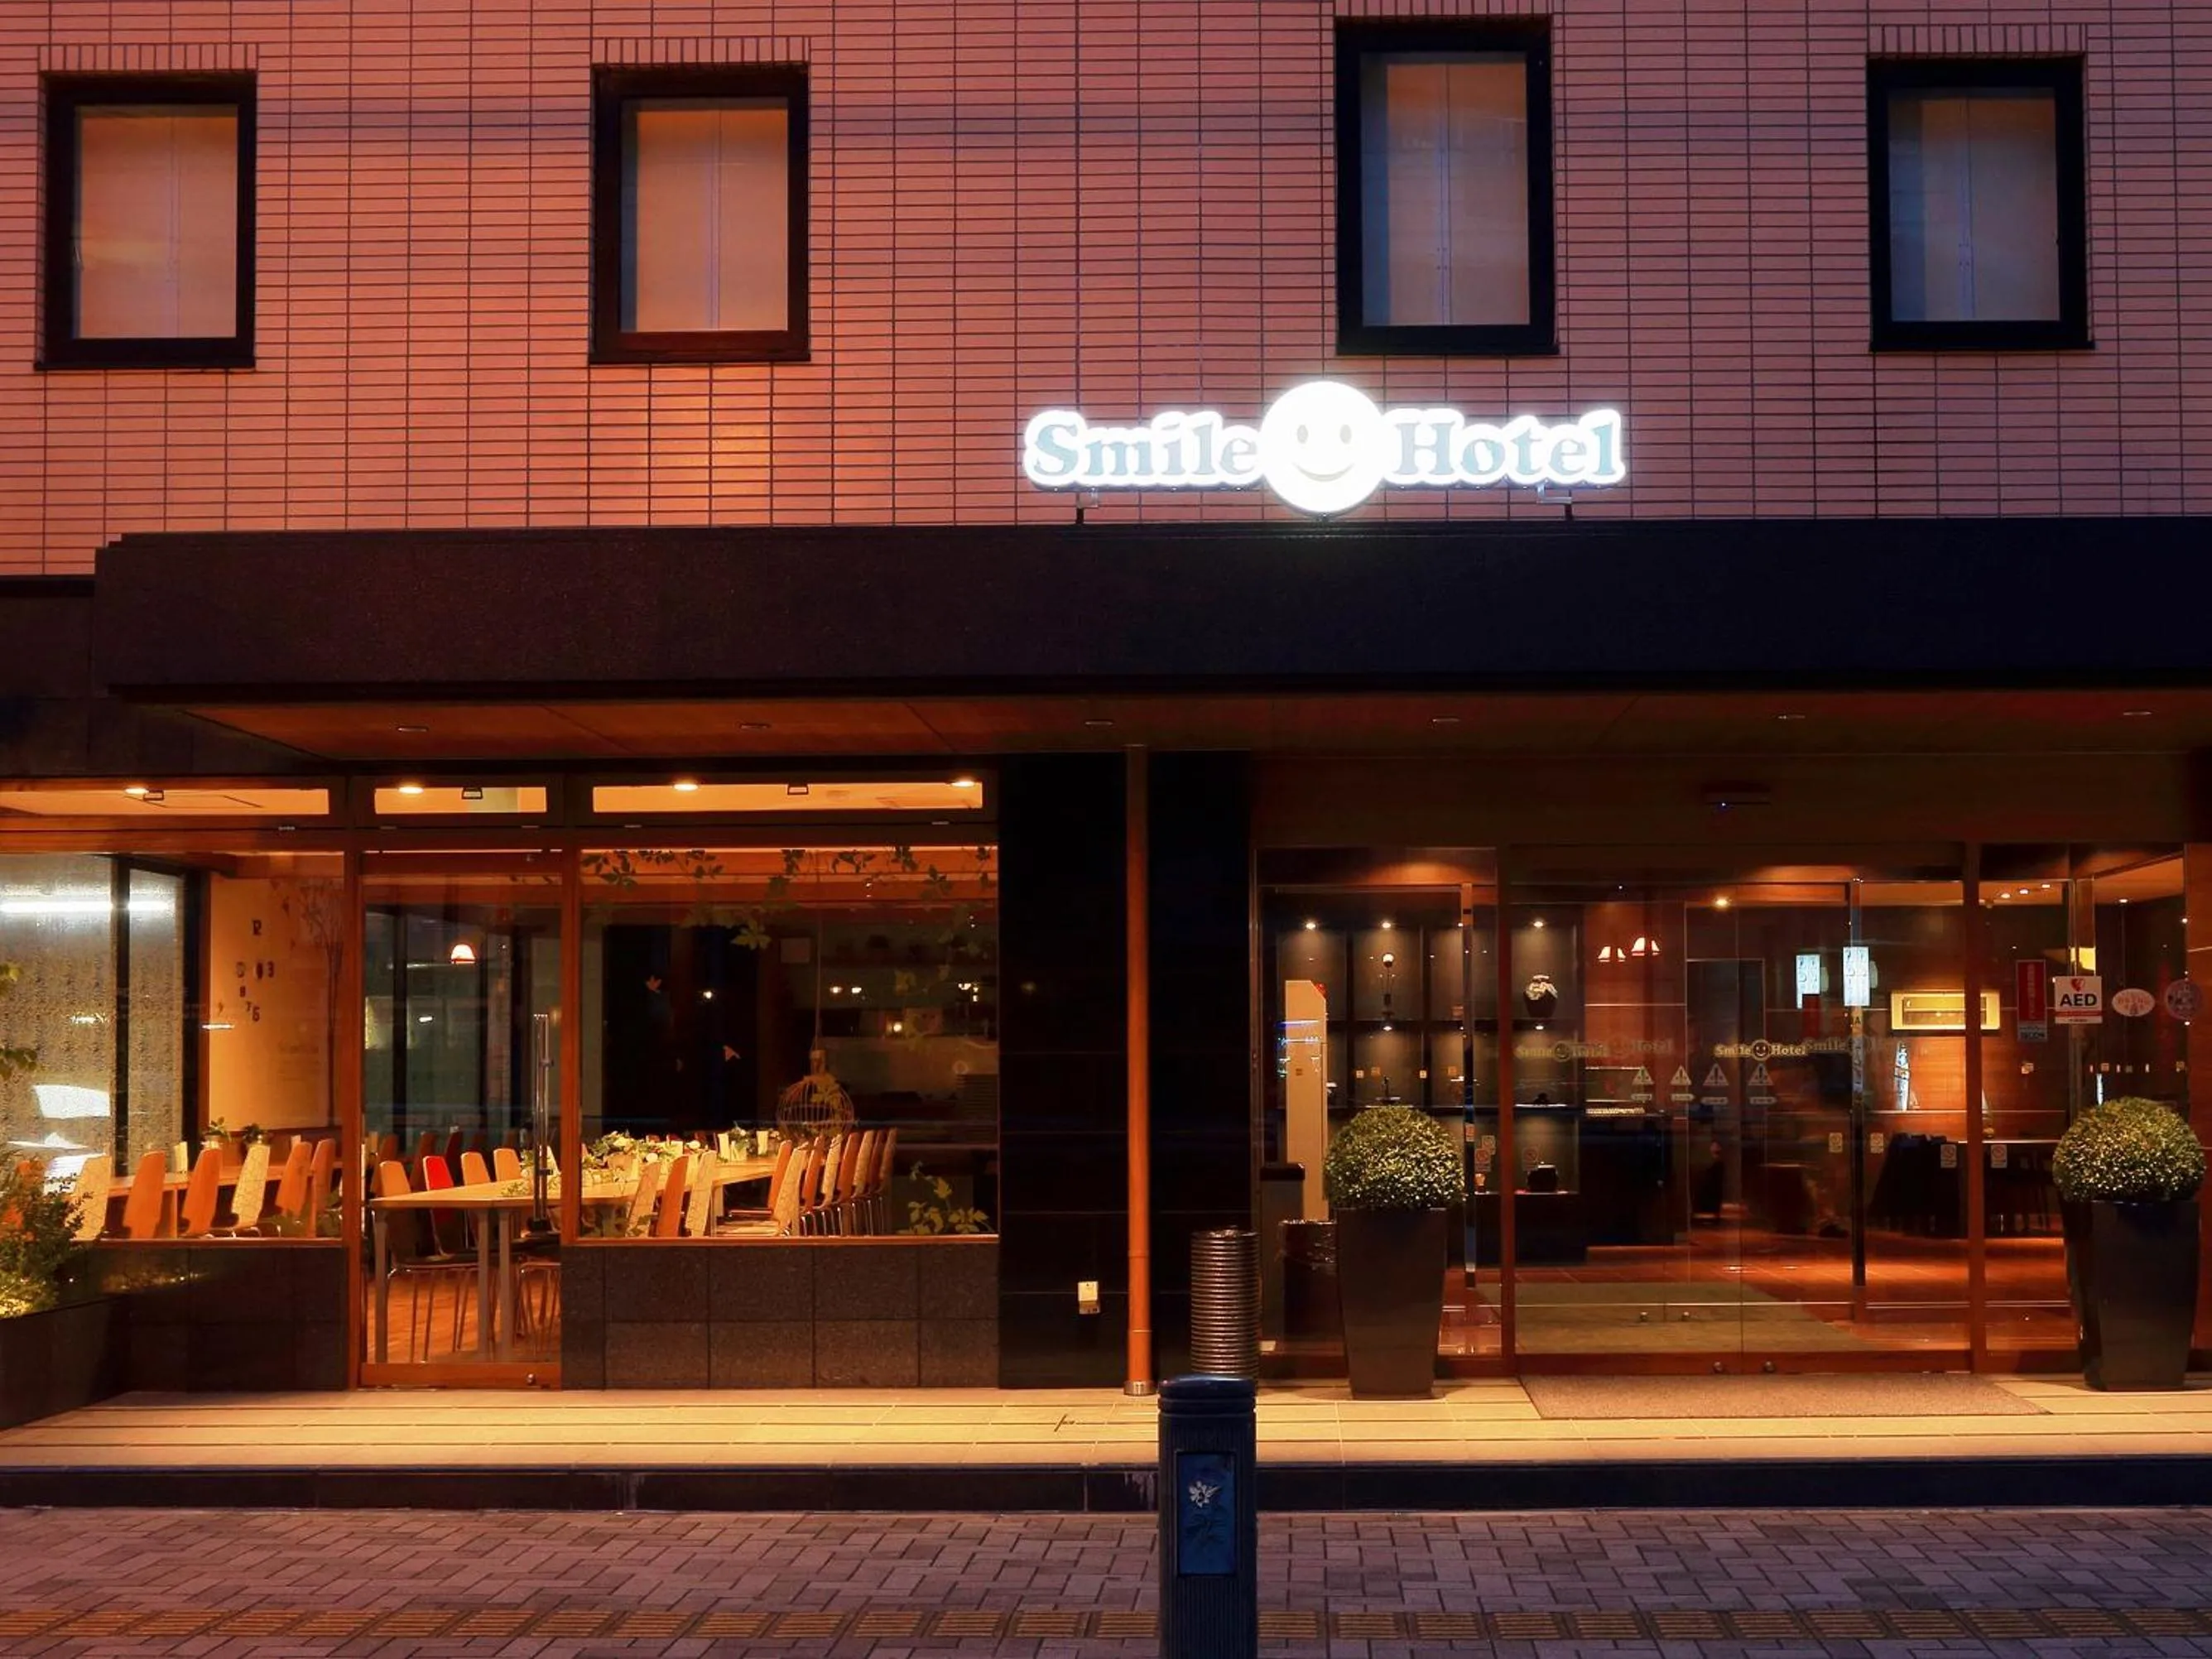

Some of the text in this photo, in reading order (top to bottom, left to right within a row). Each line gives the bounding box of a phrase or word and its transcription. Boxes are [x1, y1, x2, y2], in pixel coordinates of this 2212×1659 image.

[1031, 419, 1622, 478] Smile Hotel
[2060, 993, 2098, 1007] AED
[1714, 1041, 1807, 1057] Smile Hotel
